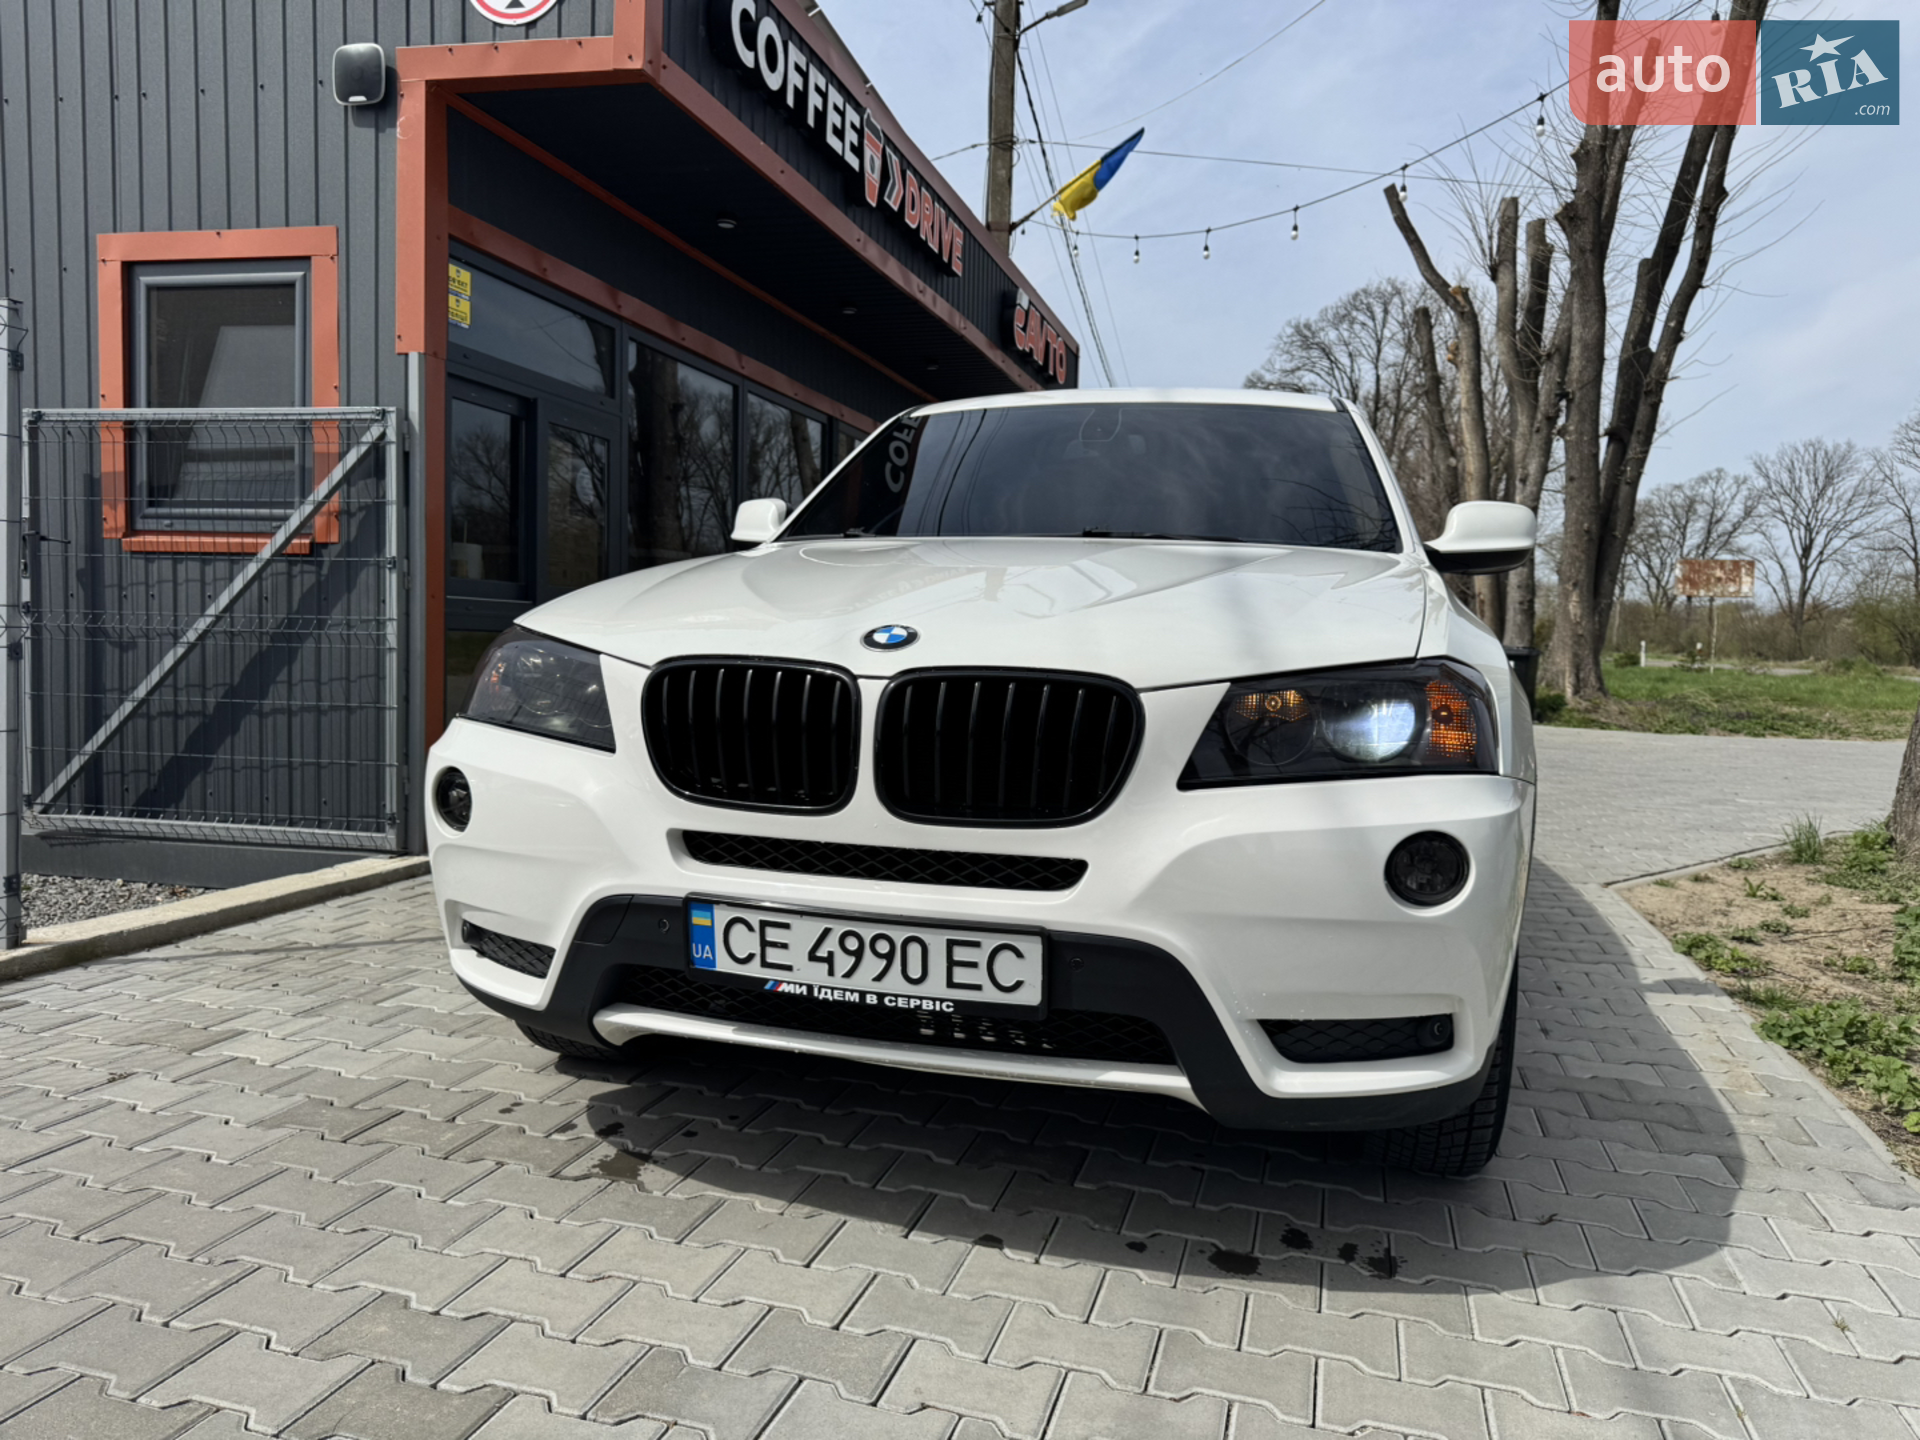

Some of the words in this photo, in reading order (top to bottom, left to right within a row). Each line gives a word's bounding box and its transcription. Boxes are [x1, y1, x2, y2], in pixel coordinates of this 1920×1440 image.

[731, 0, 861, 173] COFFEE
[905, 168, 964, 277] DRIVE
[692, 943, 714, 960] UA
[722, 915, 794, 972] CE
[807, 926, 929, 986] 4990
[944, 938, 1026, 994] EC
[778, 982, 808, 996] МИ
[812, 984, 860, 1003] ЇДЕМ
[866, 993, 879, 1005] В
[884, 996, 955, 1012] СЕРВІС
